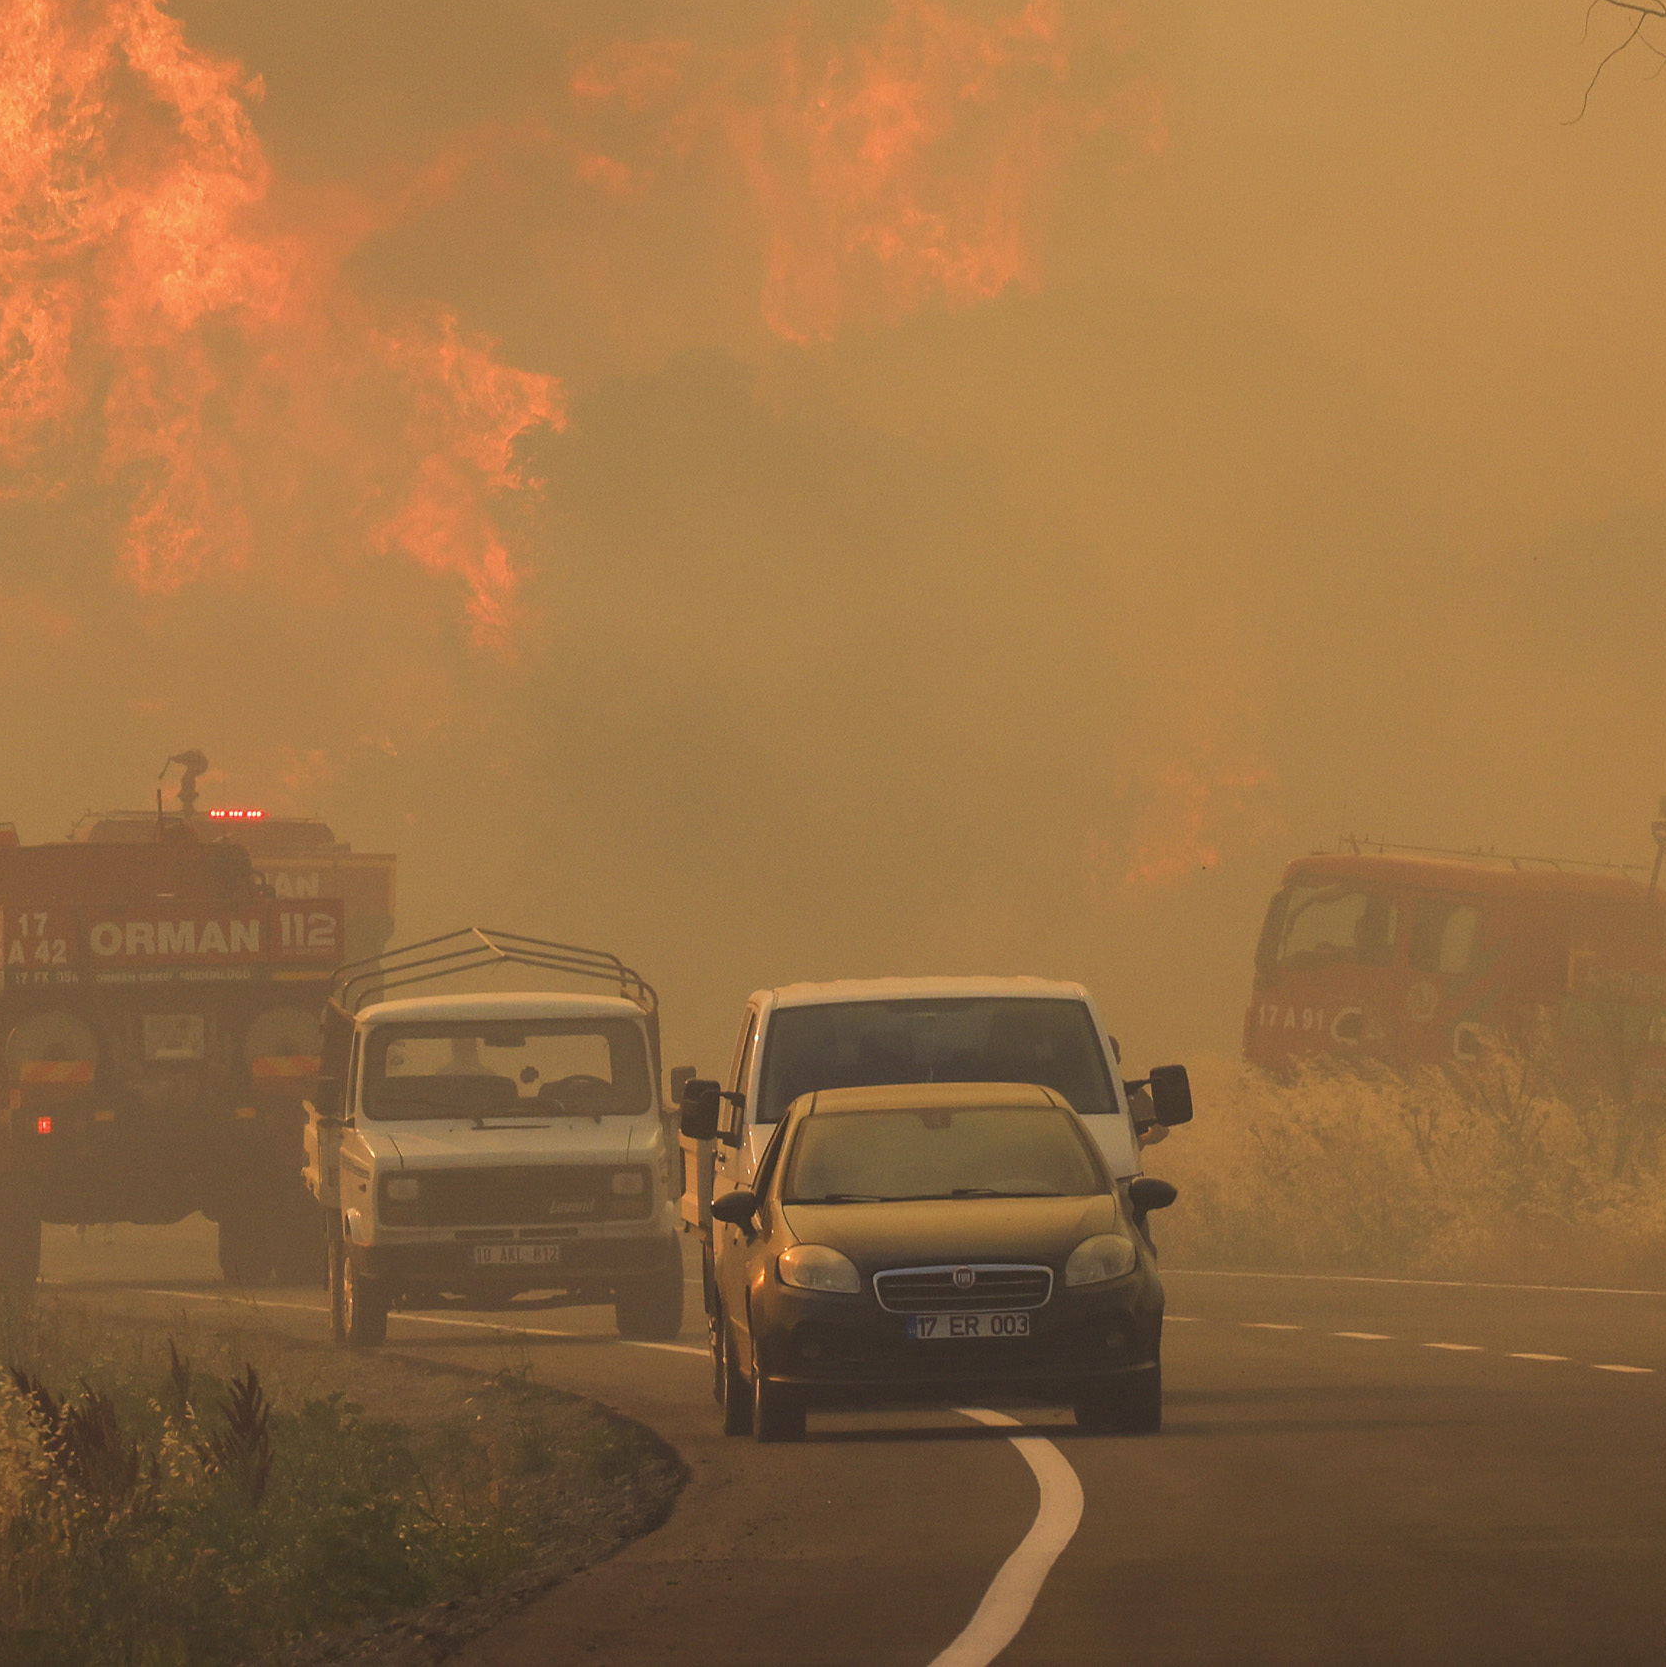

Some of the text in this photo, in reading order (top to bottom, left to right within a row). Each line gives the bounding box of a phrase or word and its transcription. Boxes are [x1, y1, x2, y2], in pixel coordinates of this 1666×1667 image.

[18, 911, 48, 937] 17
[90, 912, 337, 956] ORMAN 112
[7, 939, 25, 965] A
[34, 938, 67, 965] 42
[1258, 1004, 1324, 1031] 17 A 91
[477, 1247, 492, 1263] 10
[500, 1246, 525, 1263] AKL
[918, 1314, 1028, 1337] 17 ER 003
